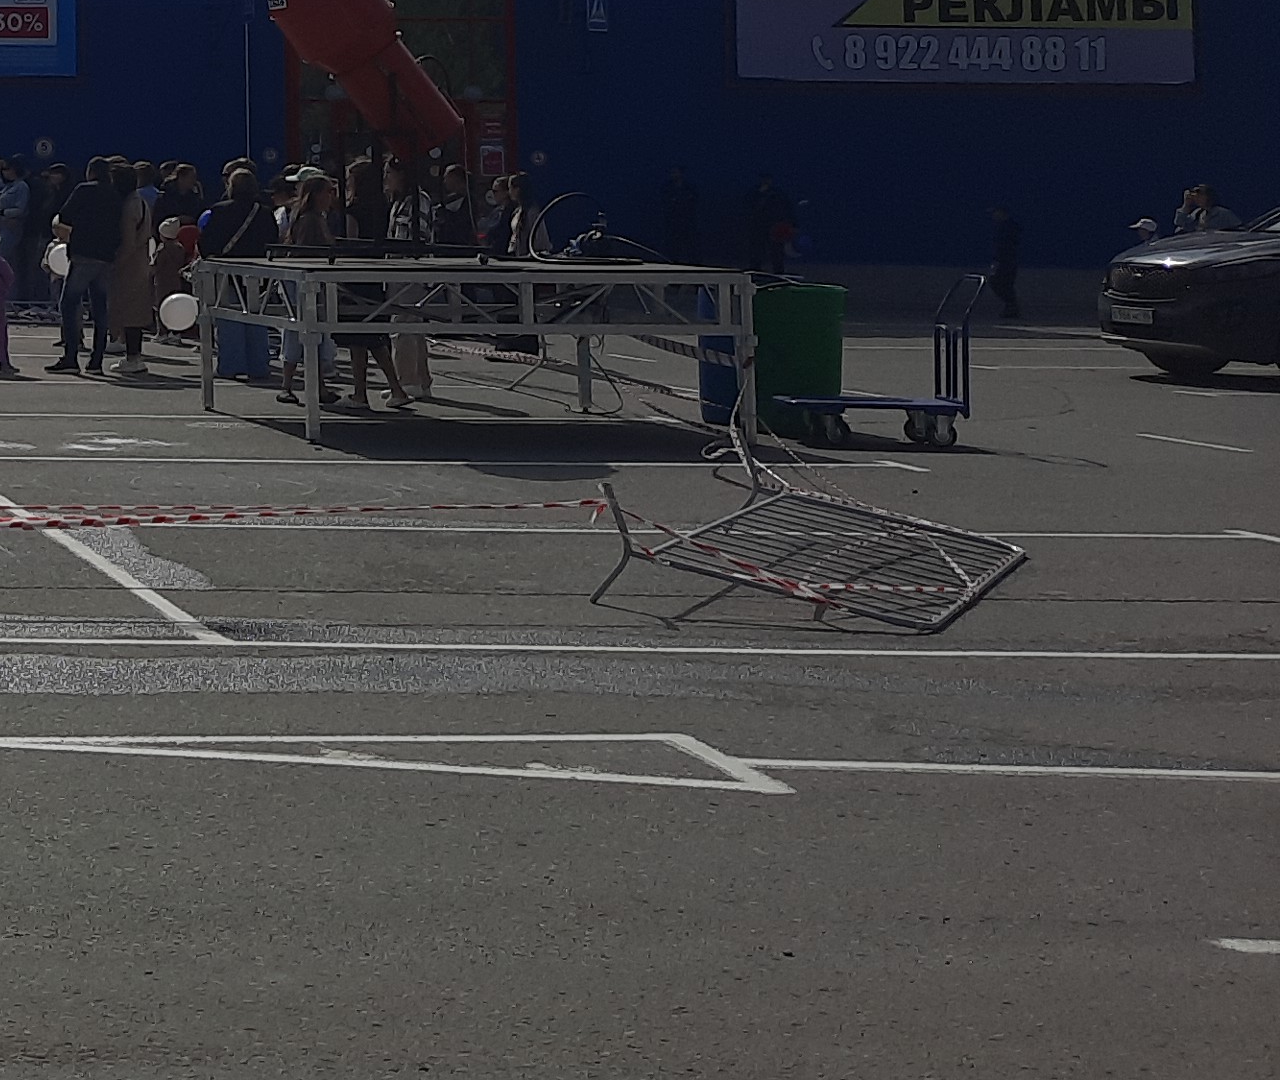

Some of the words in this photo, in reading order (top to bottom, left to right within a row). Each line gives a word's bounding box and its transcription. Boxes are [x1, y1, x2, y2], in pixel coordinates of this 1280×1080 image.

[845, 35, 866, 71] 8
[874, 35, 940, 71] 922
[948, 35, 1013, 71] 444
[1020, 35, 1066, 71] 88
[1074, 35, 1106, 71] 11
